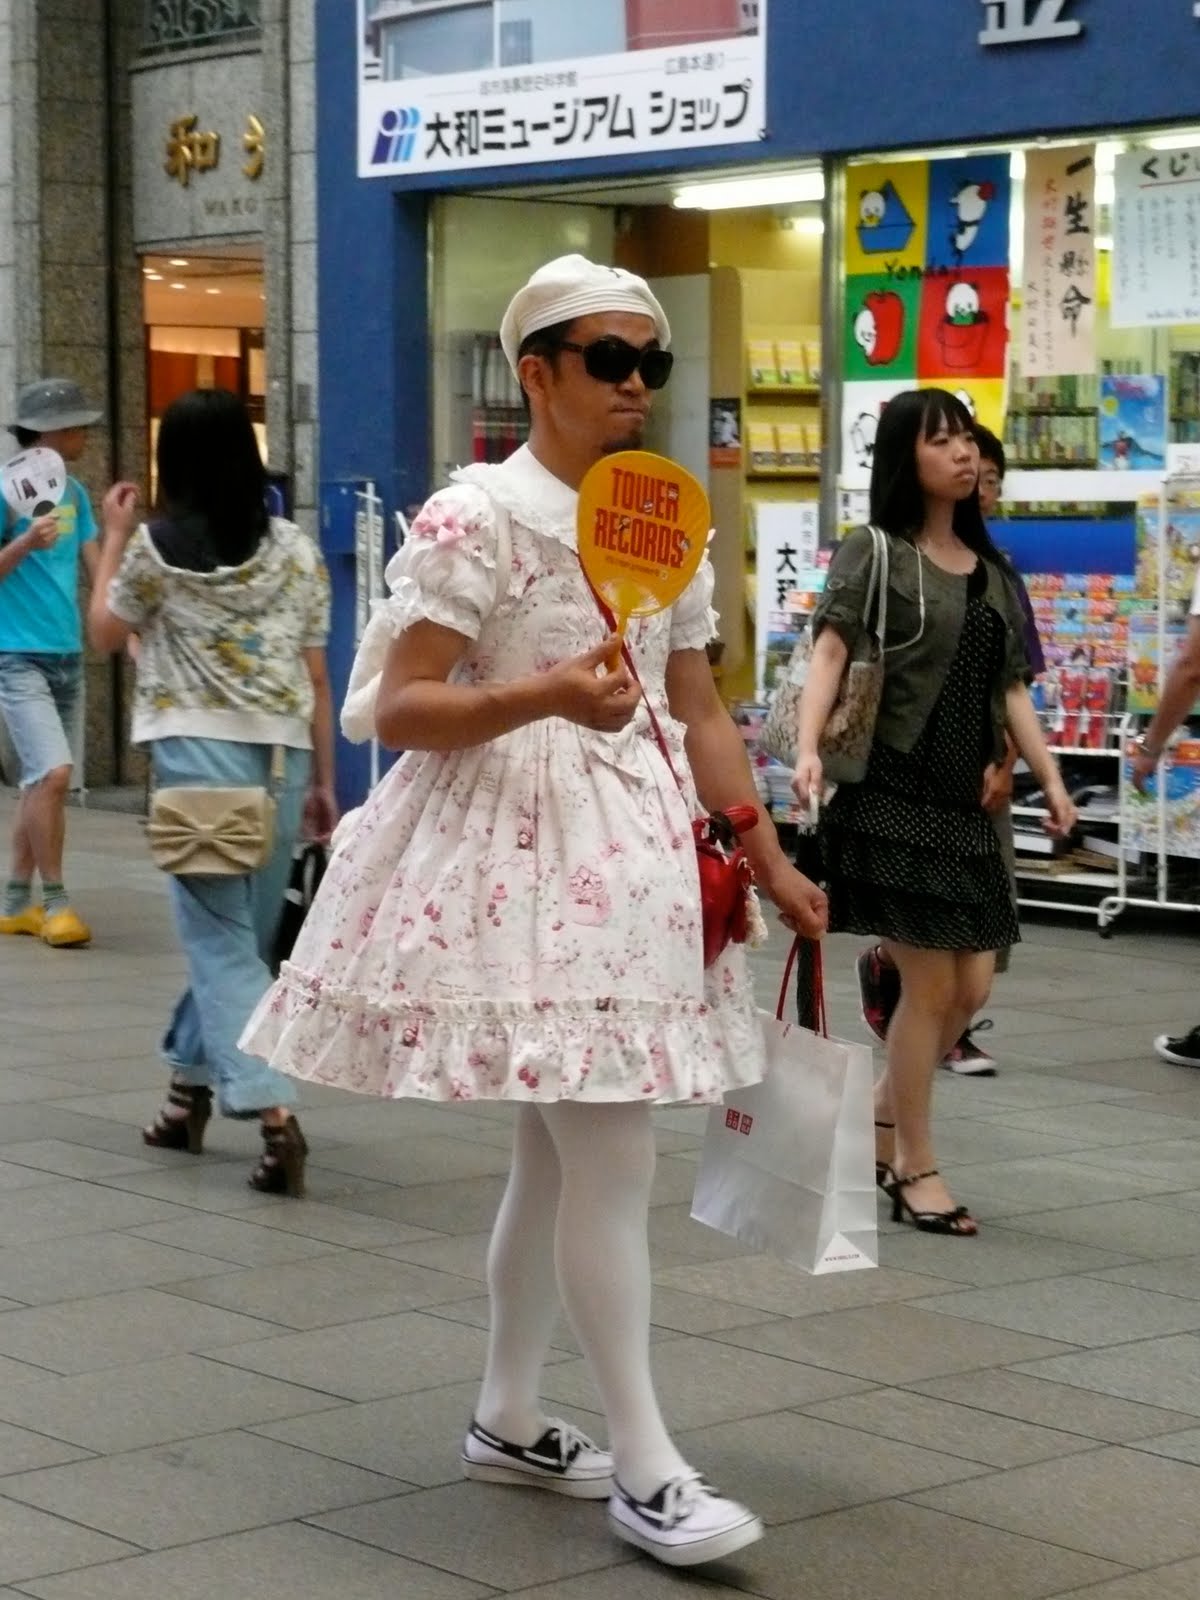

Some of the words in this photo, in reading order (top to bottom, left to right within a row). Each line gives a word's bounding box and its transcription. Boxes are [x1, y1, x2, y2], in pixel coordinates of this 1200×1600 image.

[425, 94, 636, 160] 大和ミュージアム
[650, 79, 753, 136] ショップ
[612, 467, 680, 523] TOWER
[594, 507, 687, 569] RECORDS
